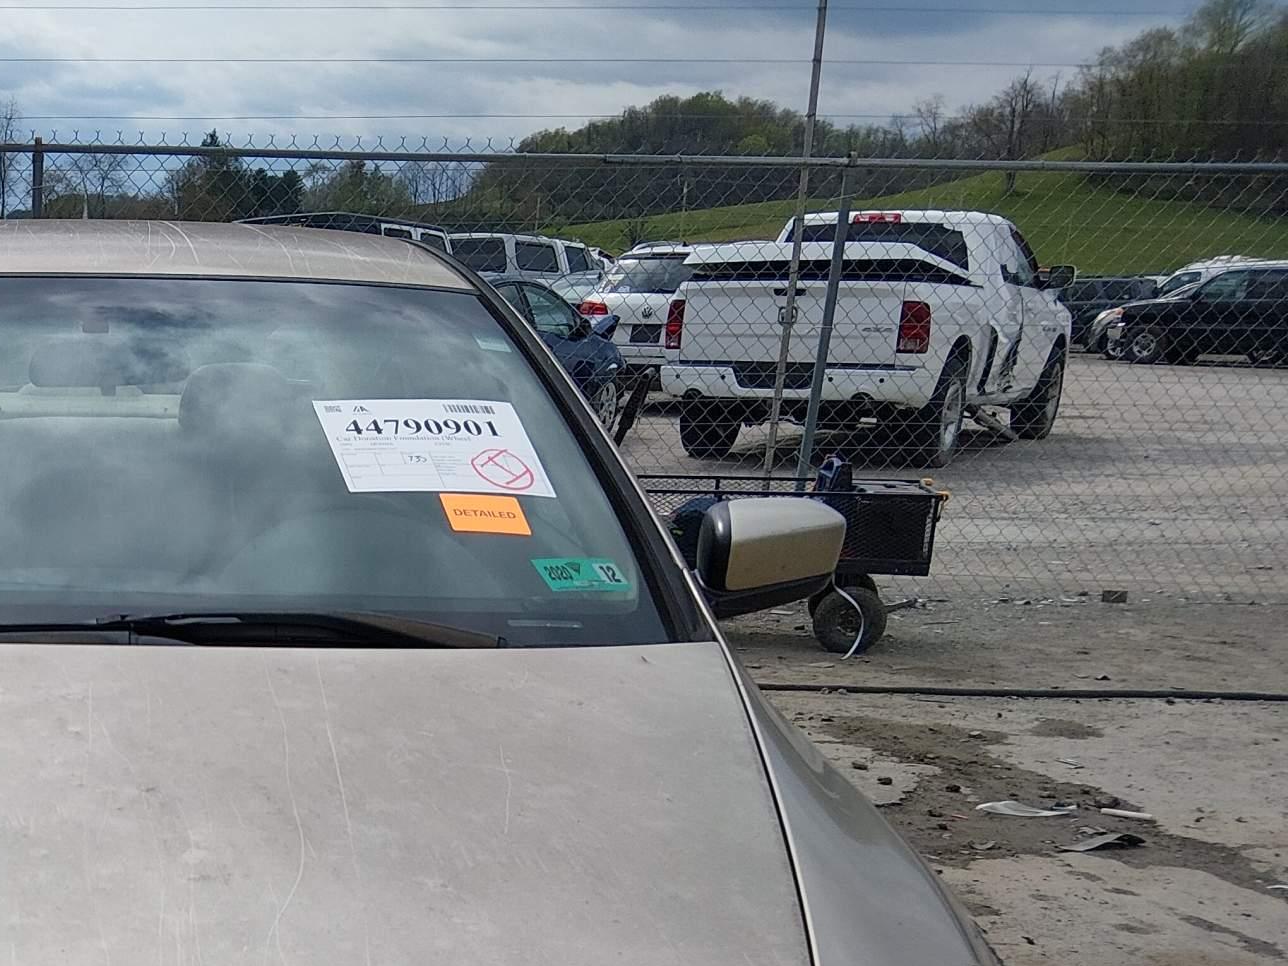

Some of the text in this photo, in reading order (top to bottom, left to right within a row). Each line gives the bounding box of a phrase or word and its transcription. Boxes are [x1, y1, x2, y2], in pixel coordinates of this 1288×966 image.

[345, 418, 503, 437] 44790901
[453, 508, 517, 520] DETAILED
[598, 565, 623, 583] 12
